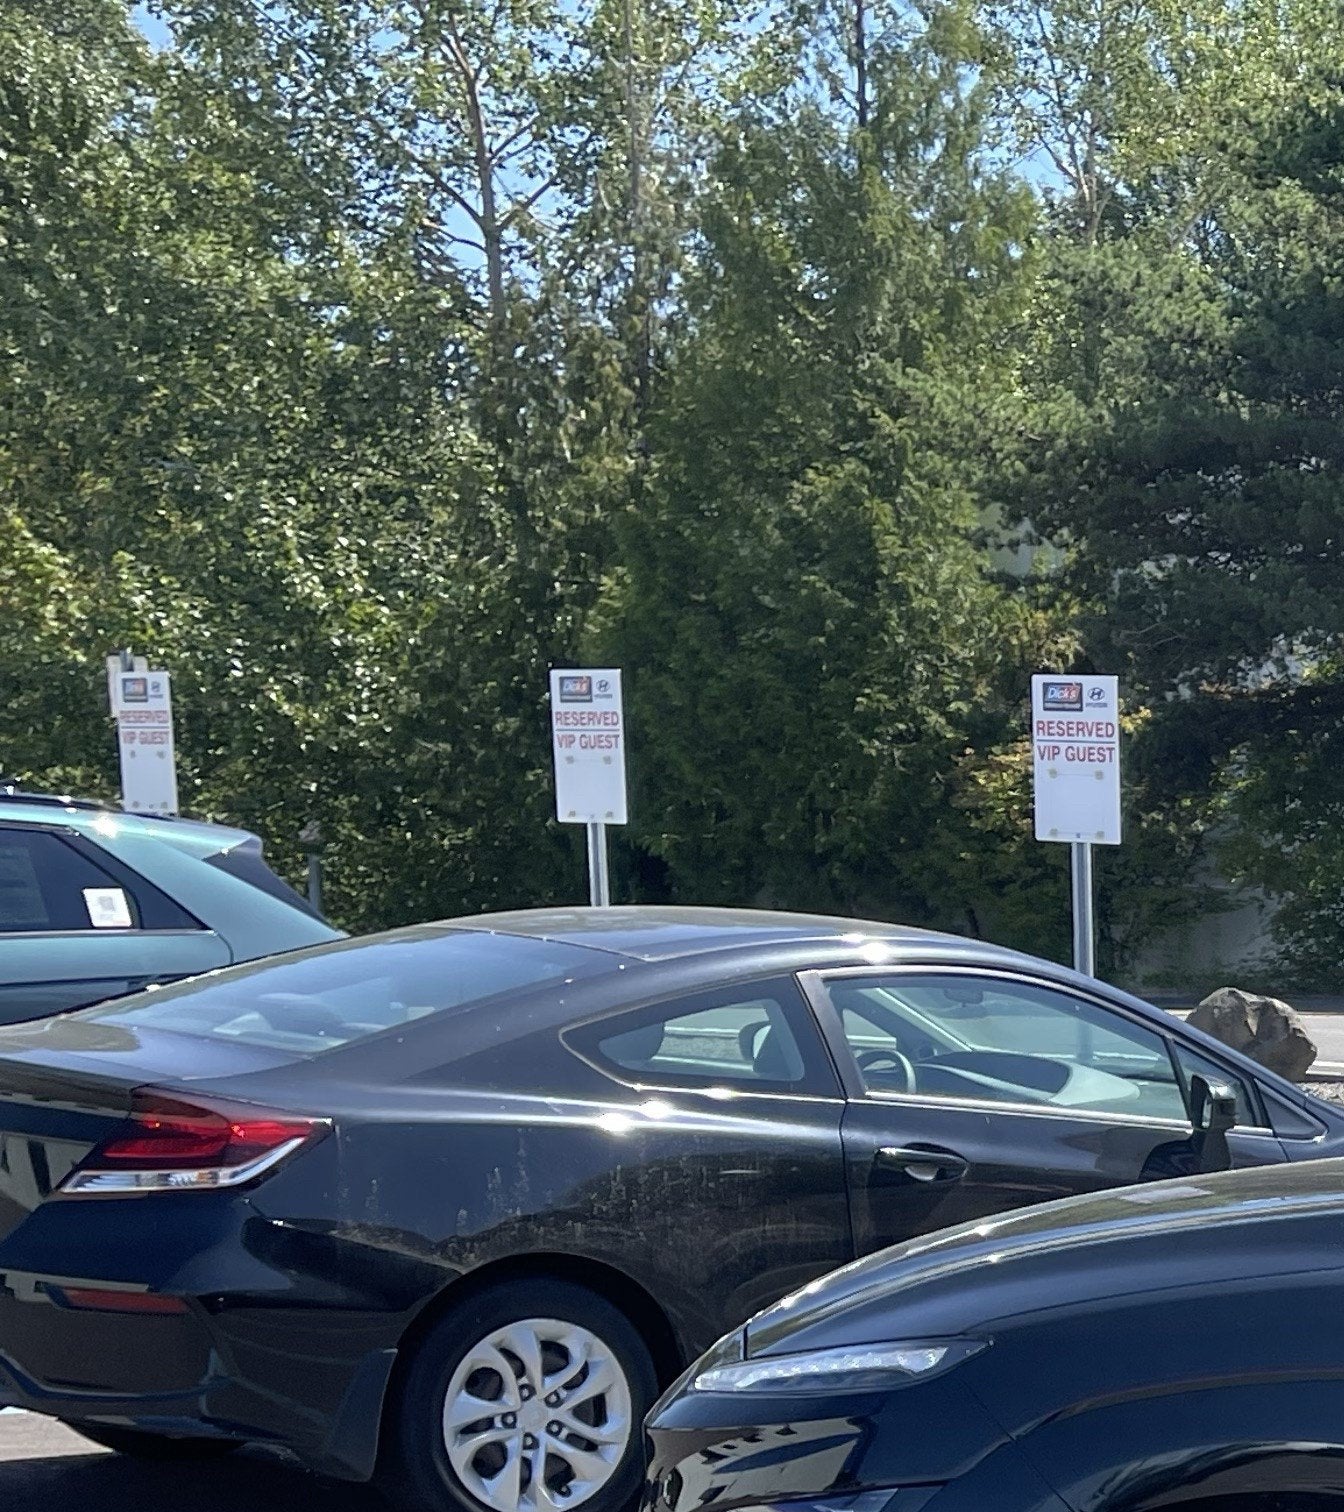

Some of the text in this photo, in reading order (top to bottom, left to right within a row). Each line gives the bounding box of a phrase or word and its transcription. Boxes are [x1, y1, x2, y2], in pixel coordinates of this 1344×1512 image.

[555, 710, 619, 726] RESERVED
[1036, 720, 1115, 738] RESERVED
[557, 733, 620, 749] VIP GUEST
[1037, 745, 1115, 763] VIP GUEST
